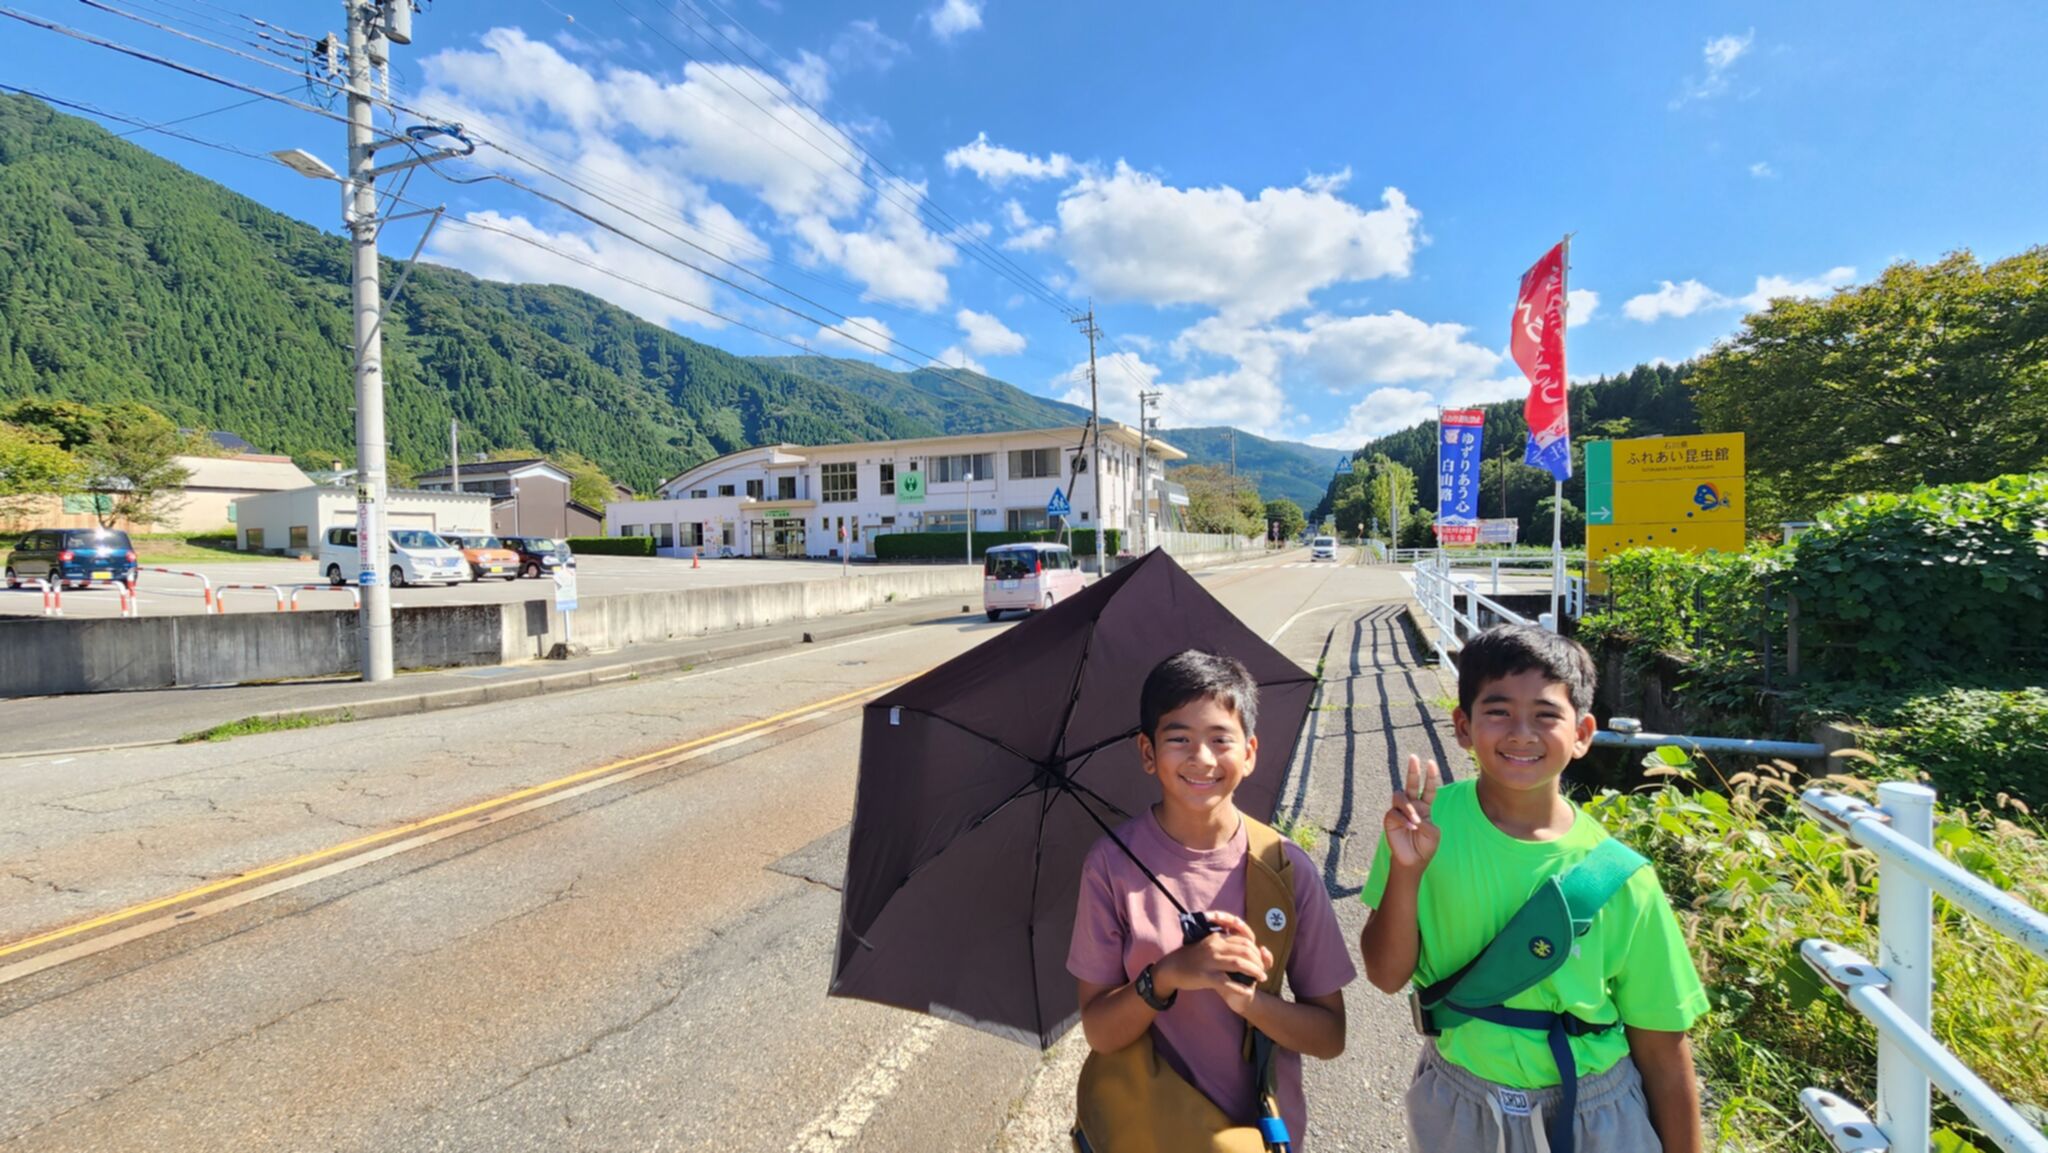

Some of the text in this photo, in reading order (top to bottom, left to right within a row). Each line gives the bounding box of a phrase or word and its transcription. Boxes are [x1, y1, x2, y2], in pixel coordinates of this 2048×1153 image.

[1456, 432, 1475, 513] ゆずりあう心
[1627, 447, 1729, 464] ふれあい昆虫館
